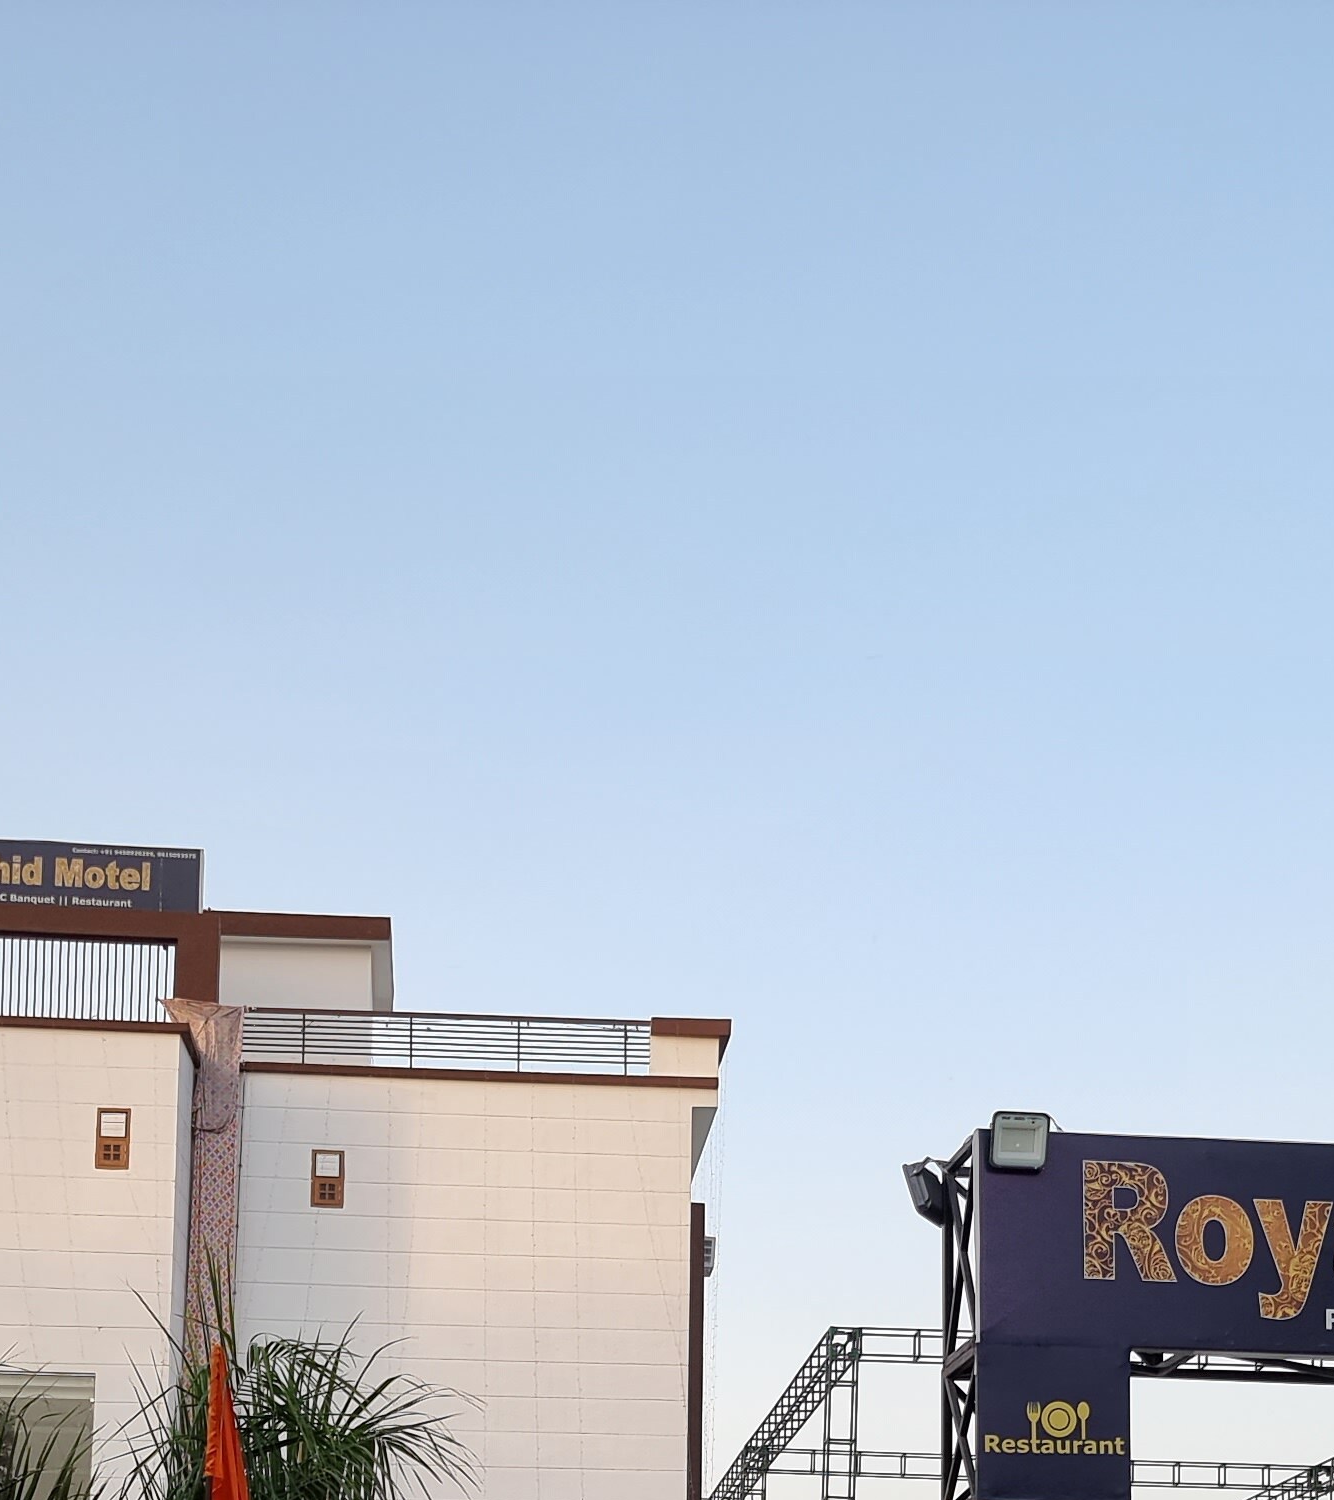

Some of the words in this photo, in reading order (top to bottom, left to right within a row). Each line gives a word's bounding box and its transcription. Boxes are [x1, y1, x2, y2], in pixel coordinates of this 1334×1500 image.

[54, 856, 151, 891] Motel
[10, 893, 56, 905] Banquet
[72, 896, 133, 908] Restaurant
[984, 1434, 1126, 1455] Restaurant
